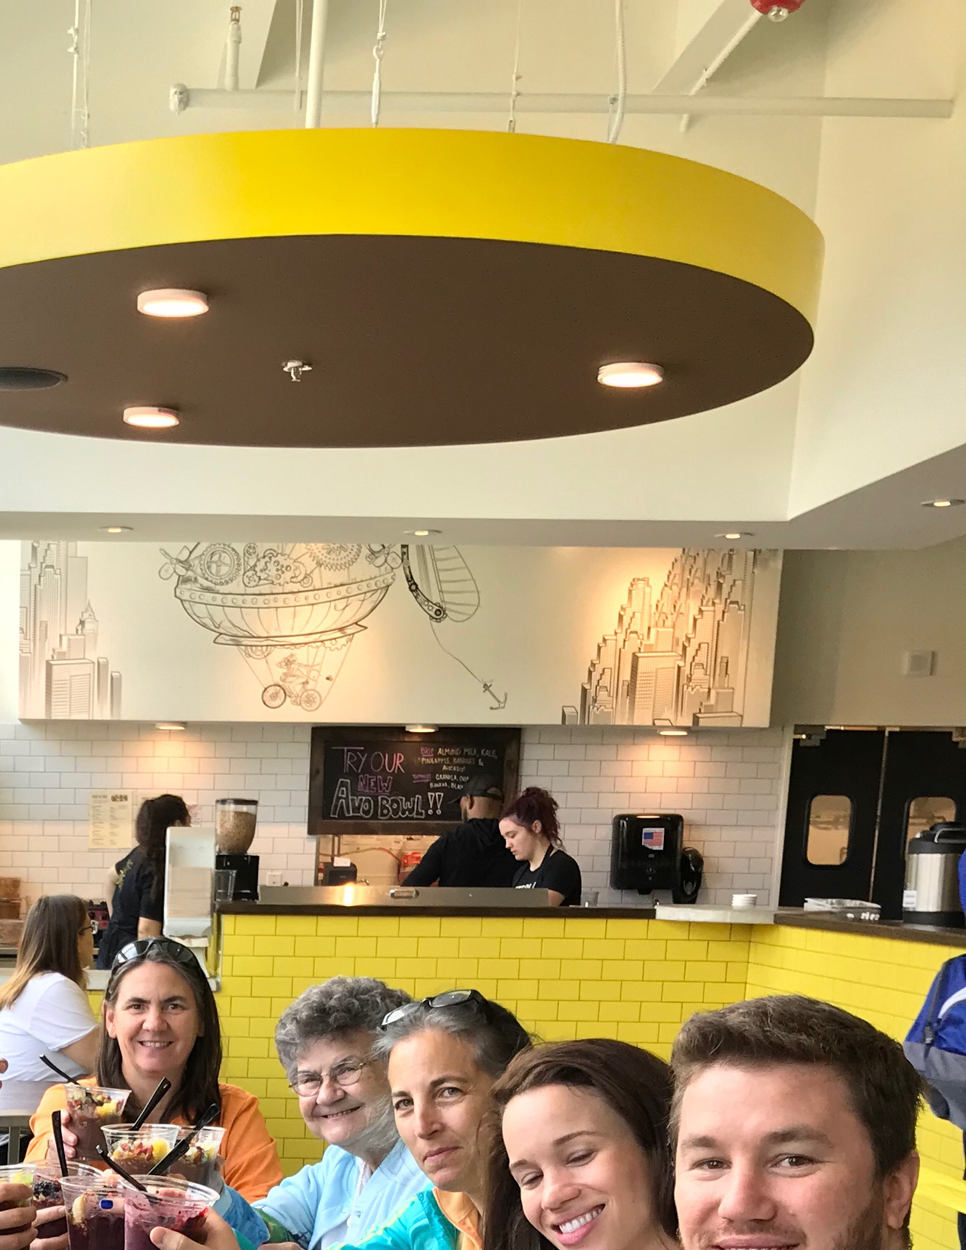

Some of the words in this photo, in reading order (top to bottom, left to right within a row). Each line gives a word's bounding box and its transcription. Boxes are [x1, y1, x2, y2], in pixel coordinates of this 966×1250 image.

[370, 751, 405, 773] OUR
[357, 774, 393, 795] NEW
[330, 779, 374, 818] AVO
